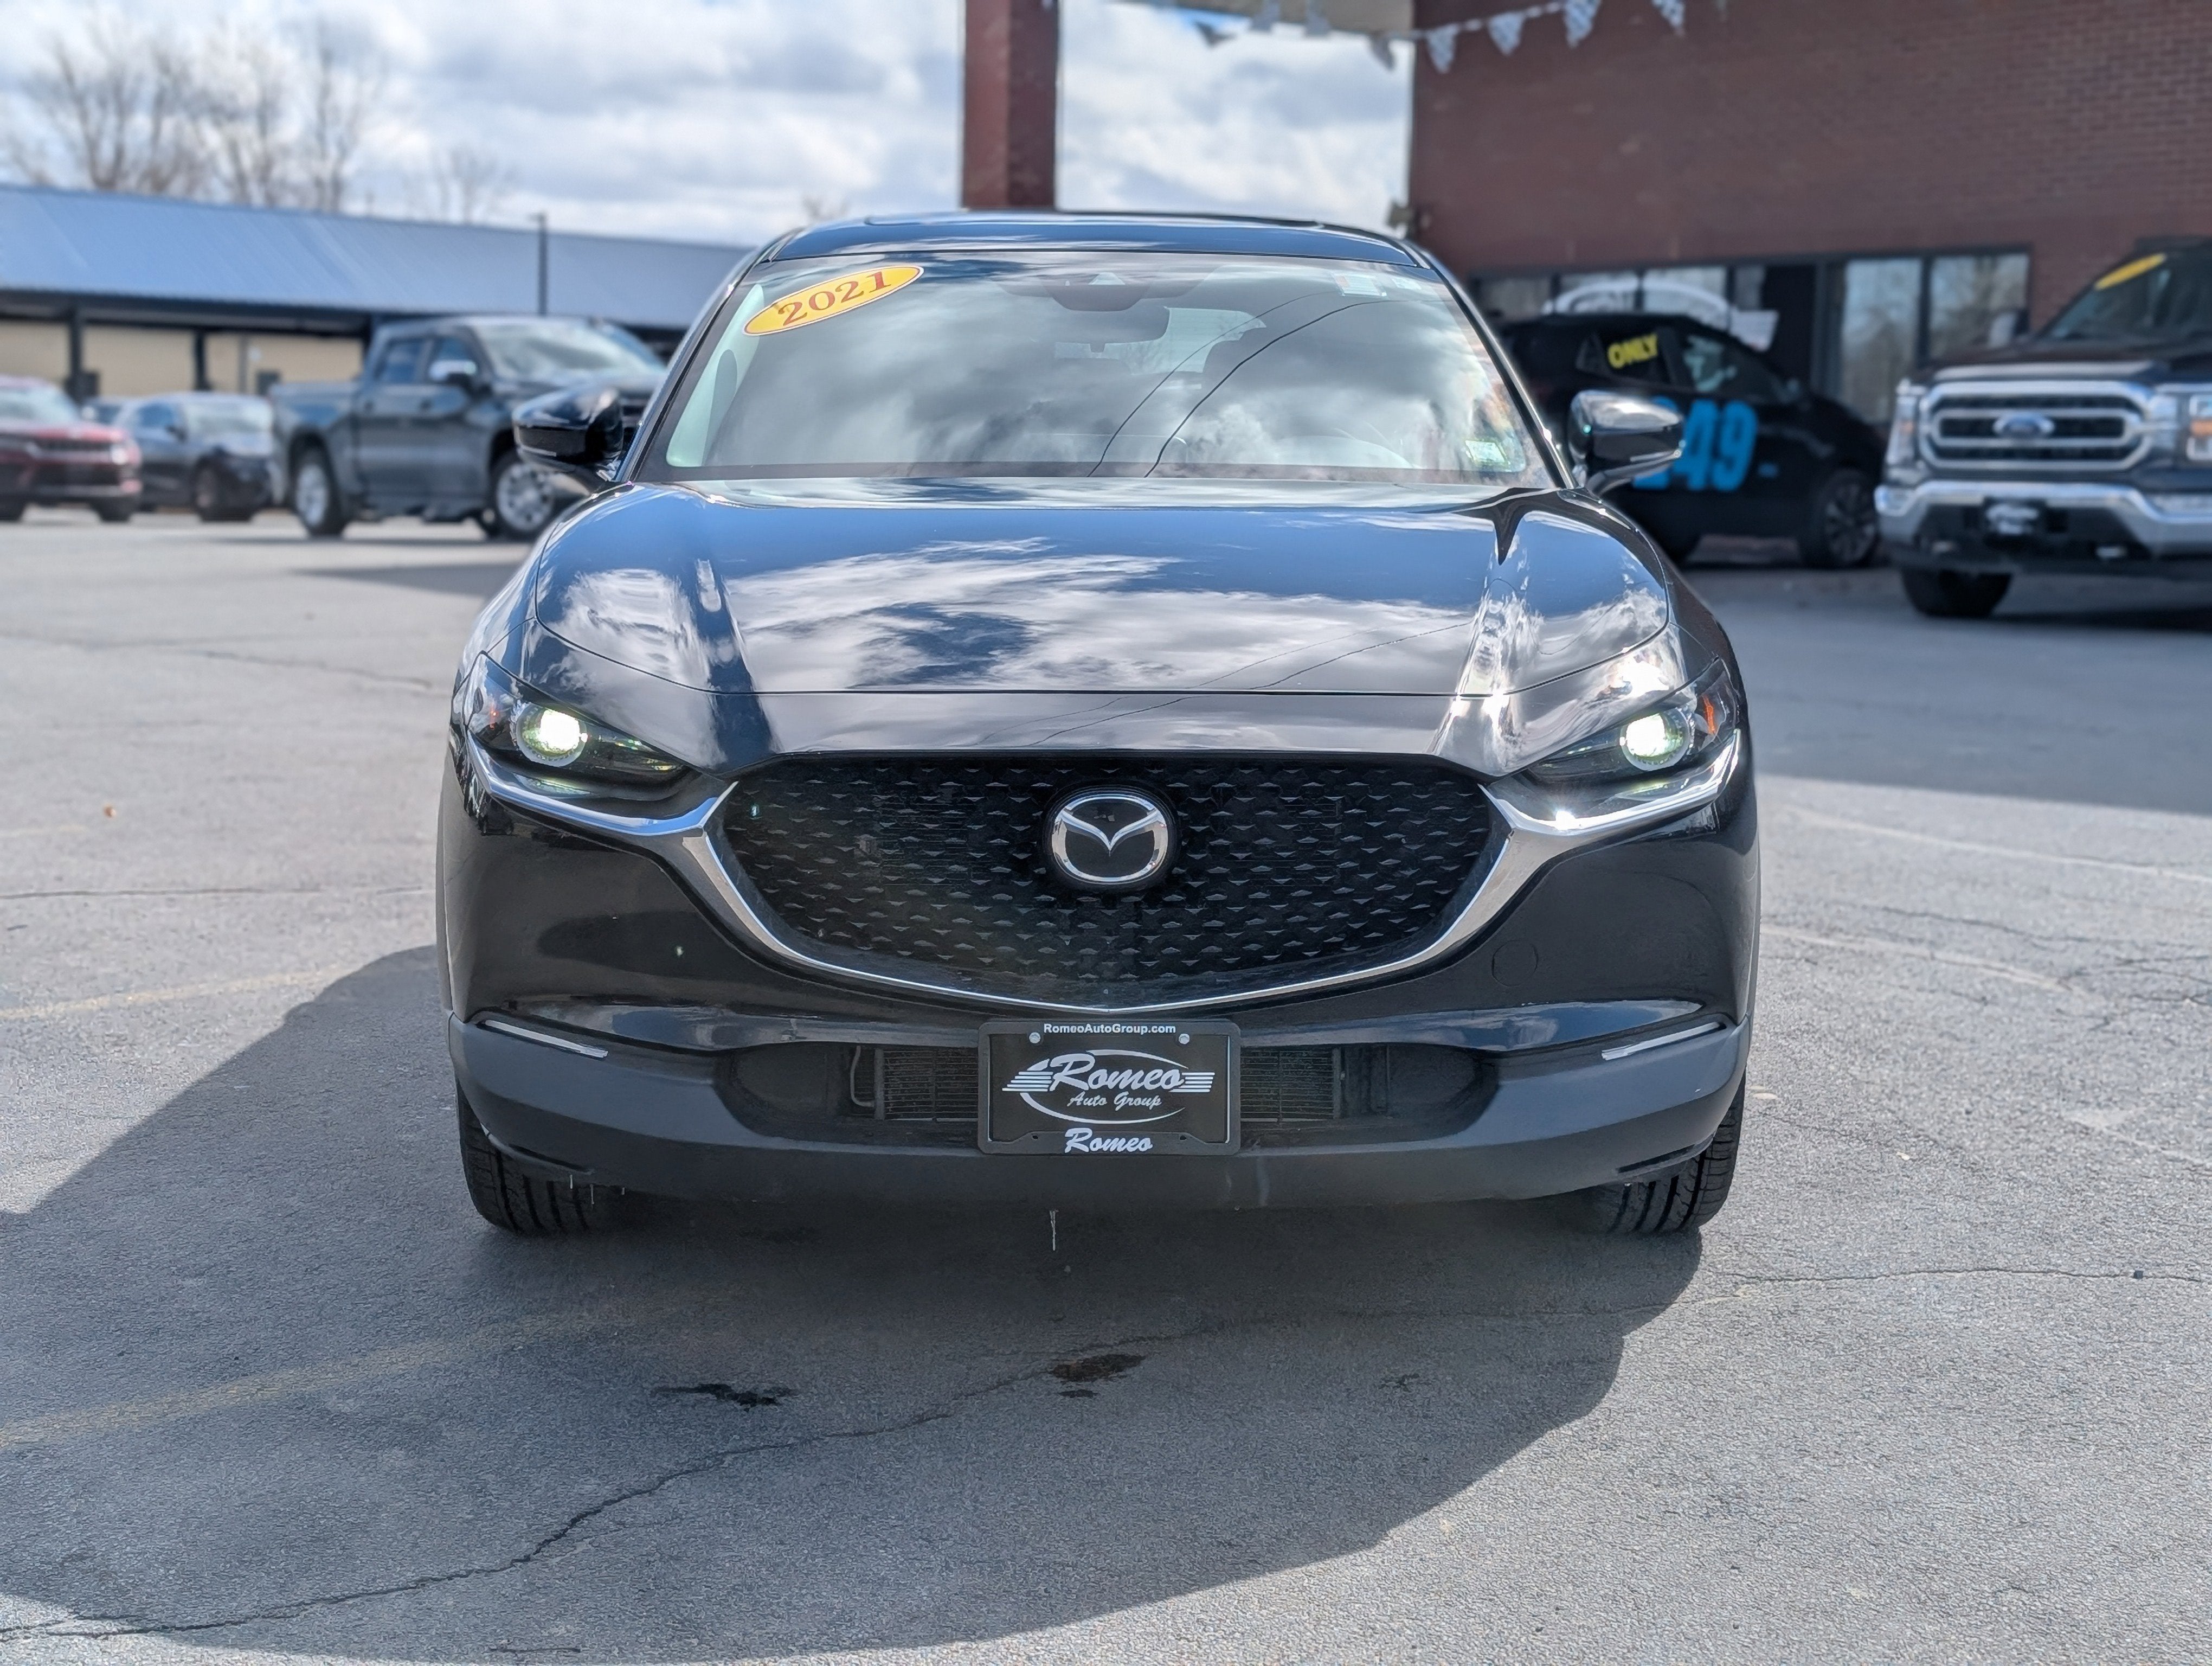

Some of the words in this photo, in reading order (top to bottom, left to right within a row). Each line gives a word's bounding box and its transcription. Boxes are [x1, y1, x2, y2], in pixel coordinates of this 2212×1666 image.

[778, 271, 891, 326] 2021
[1043, 1023, 1176, 1034] RomeoAutoGroup.com
[1049, 1053, 1185, 1091] Romeo
[1066, 1091, 1108, 1107] Auto
[1114, 1092, 1162, 1111] Group
[1064, 1127, 1153, 1154] Romeo
